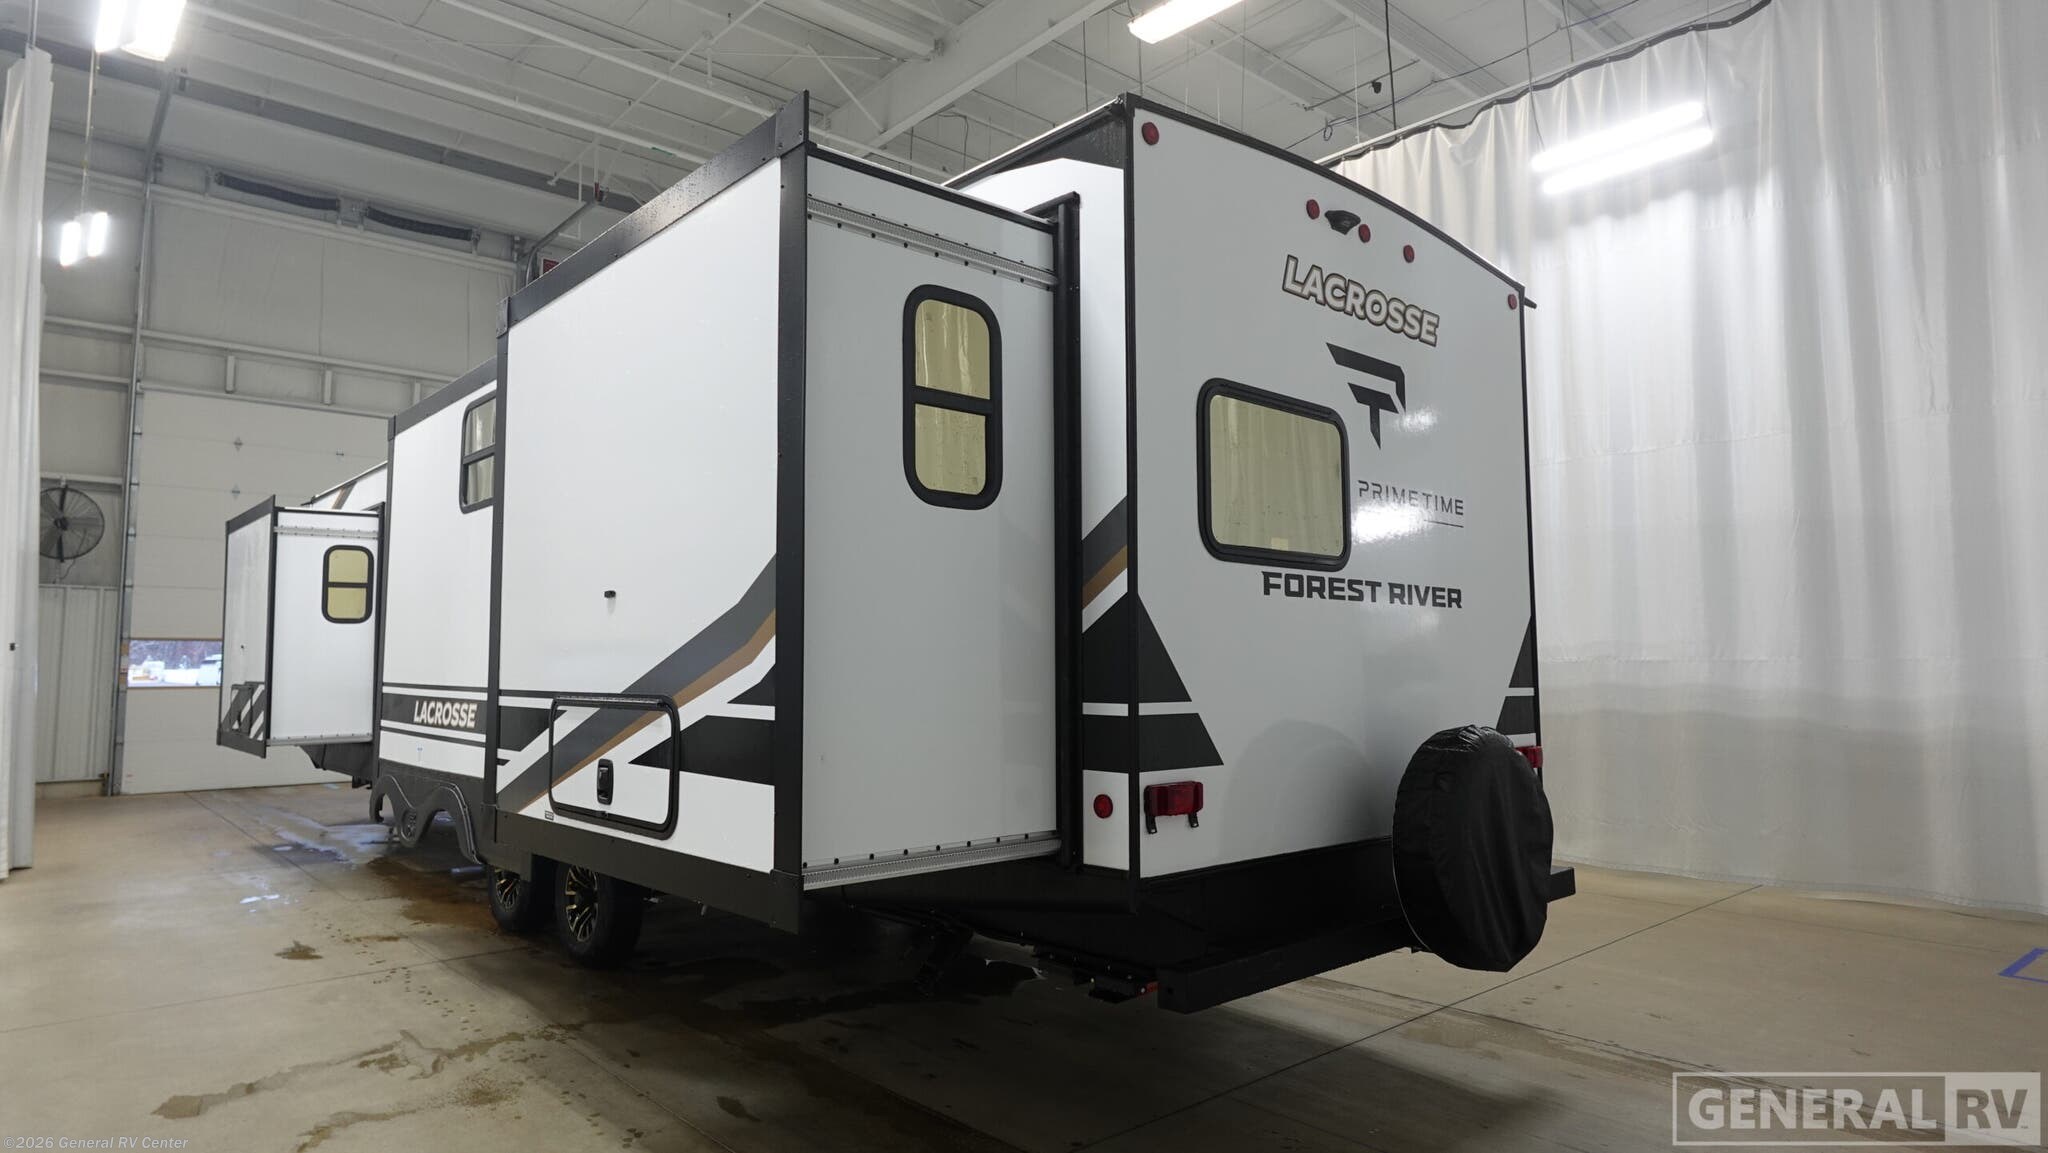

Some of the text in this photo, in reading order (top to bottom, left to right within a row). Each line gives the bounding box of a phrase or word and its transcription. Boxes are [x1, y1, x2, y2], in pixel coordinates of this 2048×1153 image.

[1282, 255, 1440, 346] LACROSSE
[1262, 571, 1462, 609] FOREST RIVER
[413, 700, 477, 729] LACROSSE
